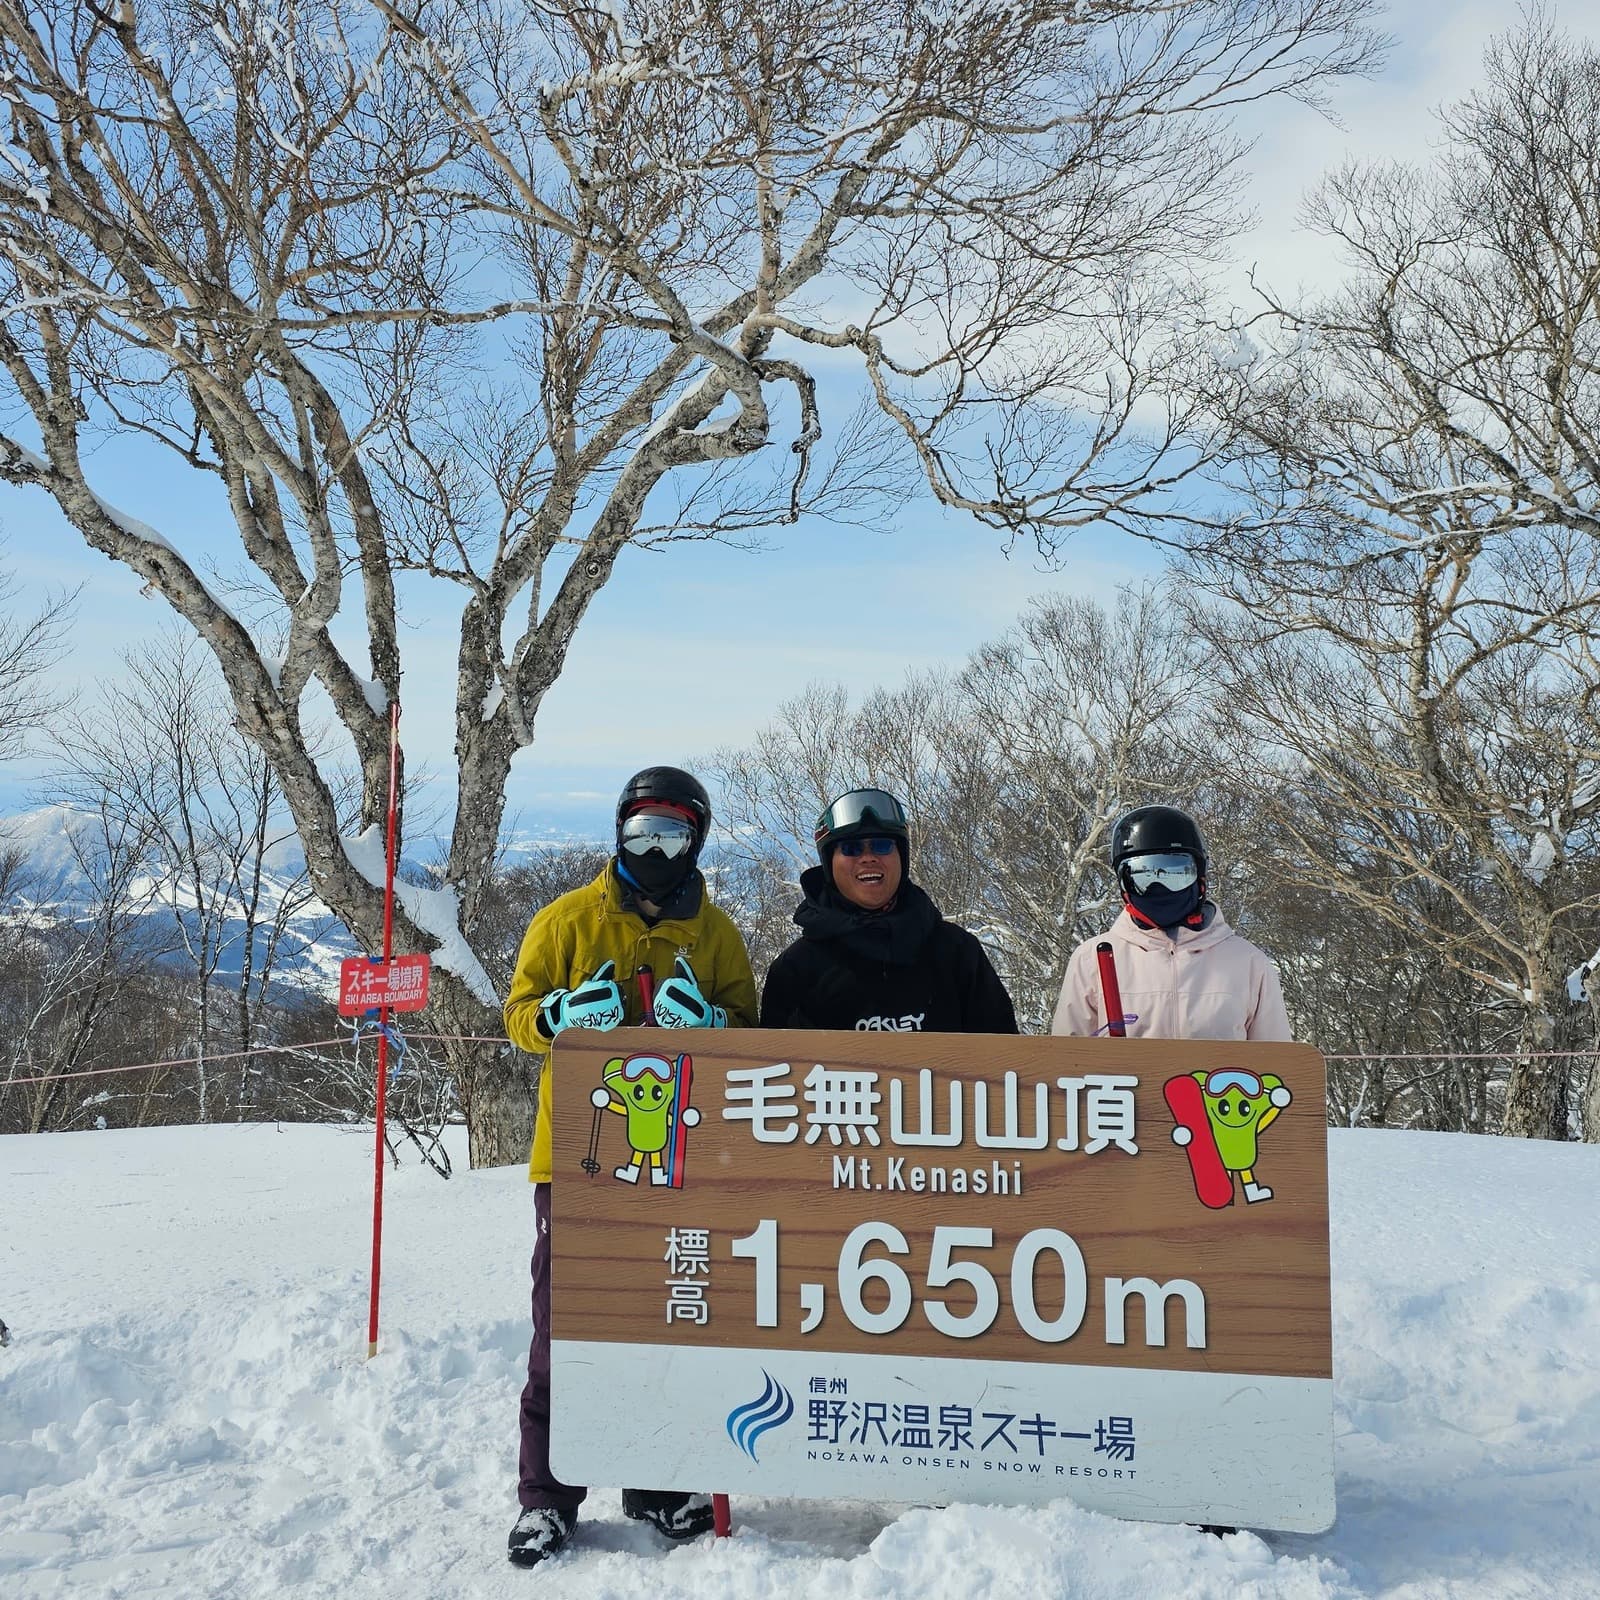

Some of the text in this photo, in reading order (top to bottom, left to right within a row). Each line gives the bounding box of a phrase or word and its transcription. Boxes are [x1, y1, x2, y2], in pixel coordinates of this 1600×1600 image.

[347, 966, 423, 992] スキー場境界
[345, 988, 424, 1005] SKI AREA BOUNDARY
[855, 1013, 925, 1032] OAKLEY
[722, 1063, 1139, 1155] 毛無山山頂
[664, 1227, 710, 1325] 標高
[808, 1376, 848, 1395] 信州
[807, 1399, 1136, 1462] 野沢温泉スキー場
[807, 1451, 1137, 1479] NOZAWA ONSEN SNOW RESORT
